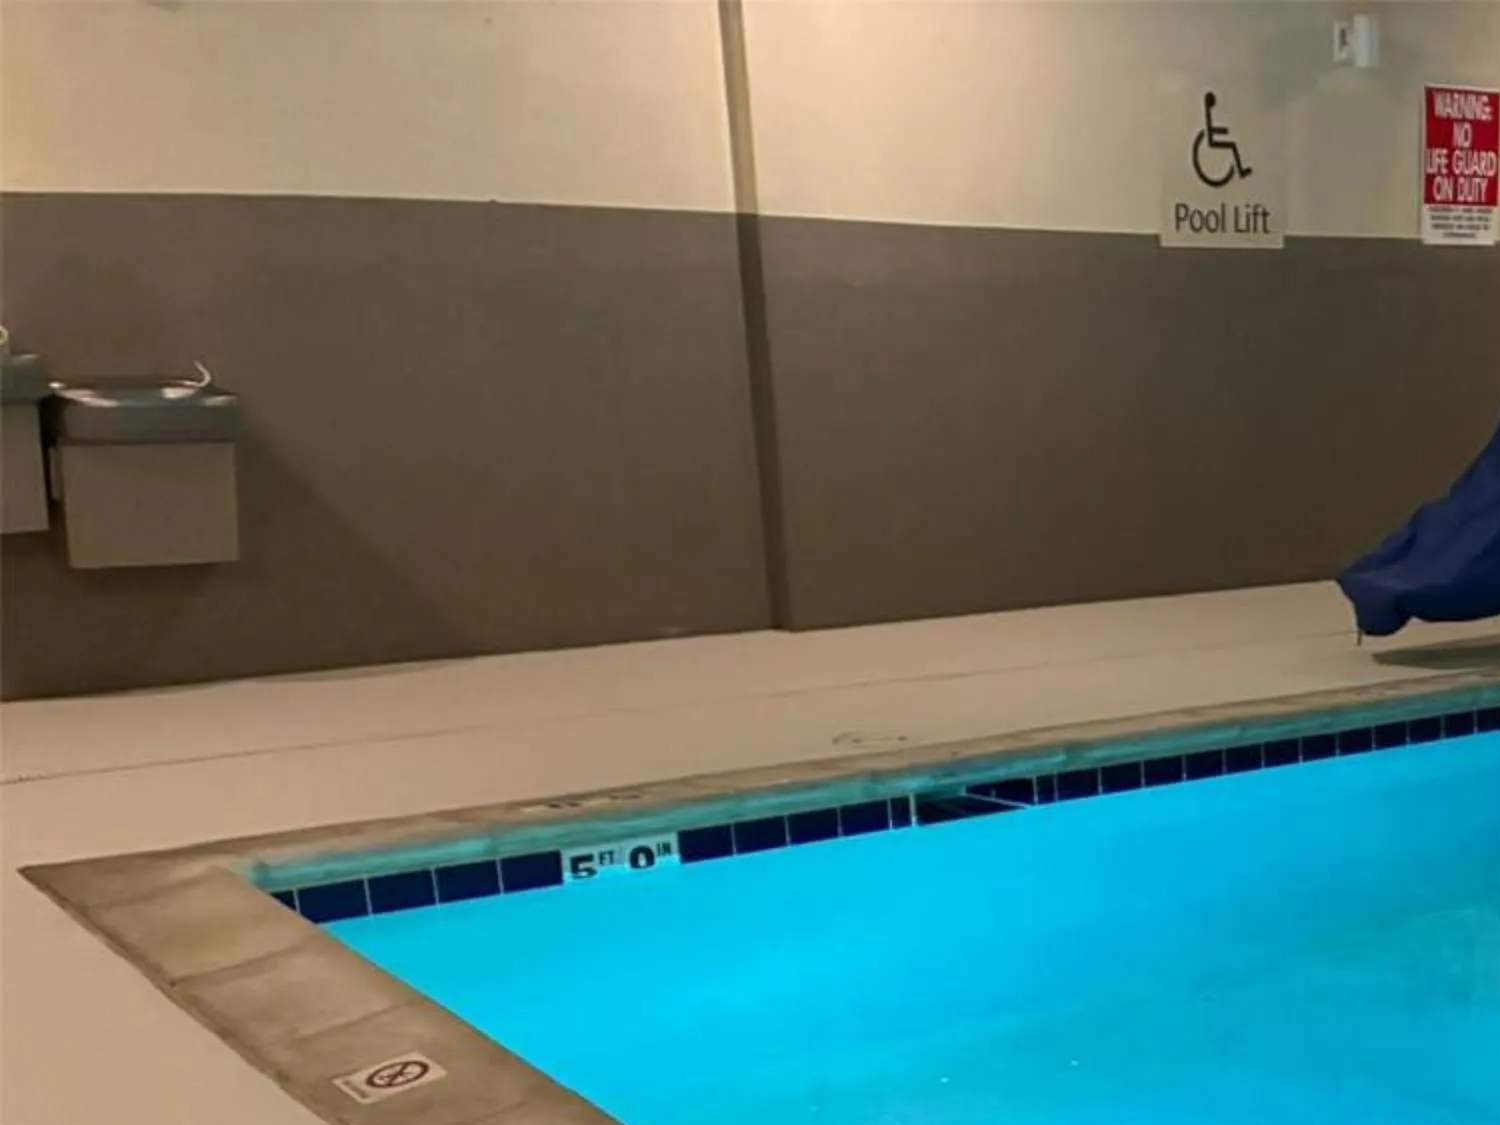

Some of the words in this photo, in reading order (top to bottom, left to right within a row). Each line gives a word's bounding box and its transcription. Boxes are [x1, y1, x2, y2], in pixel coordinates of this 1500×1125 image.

[1453, 122, 1472, 148] NO
[1426, 148, 1449, 174] LIFE
[1452, 149, 1497, 177] GUARD
[1432, 175, 1453, 202] ON
[1457, 177, 1488, 203] DUTY
[1175, 201, 1226, 234] Pool
[1234, 203, 1271, 235] Lift
[569, 853, 598, 879] 5
[629, 845, 655, 870] 0
